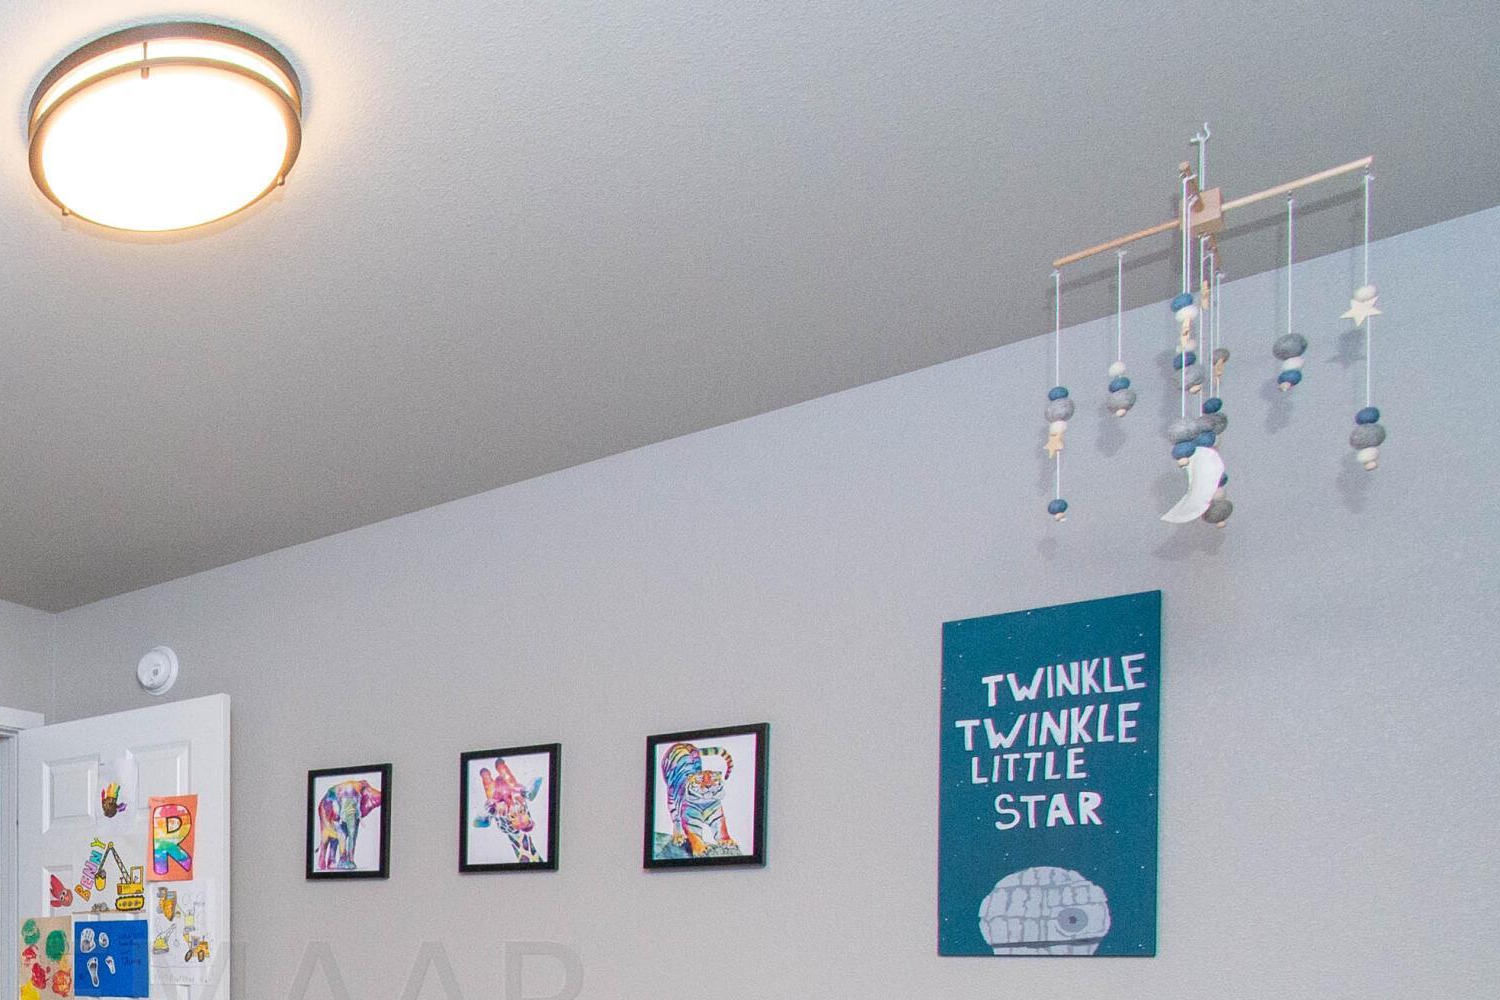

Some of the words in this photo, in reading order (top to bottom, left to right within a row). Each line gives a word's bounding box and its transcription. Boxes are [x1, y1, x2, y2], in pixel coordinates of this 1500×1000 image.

[981, 653, 1146, 707] TWINKLE
[955, 702, 1141, 751] TWINKLE
[971, 747, 1088, 784] LITTLE
[994, 791, 1103, 831] STAR
[153, 803, 193, 876] R
[74, 837, 106, 902] BENNY
